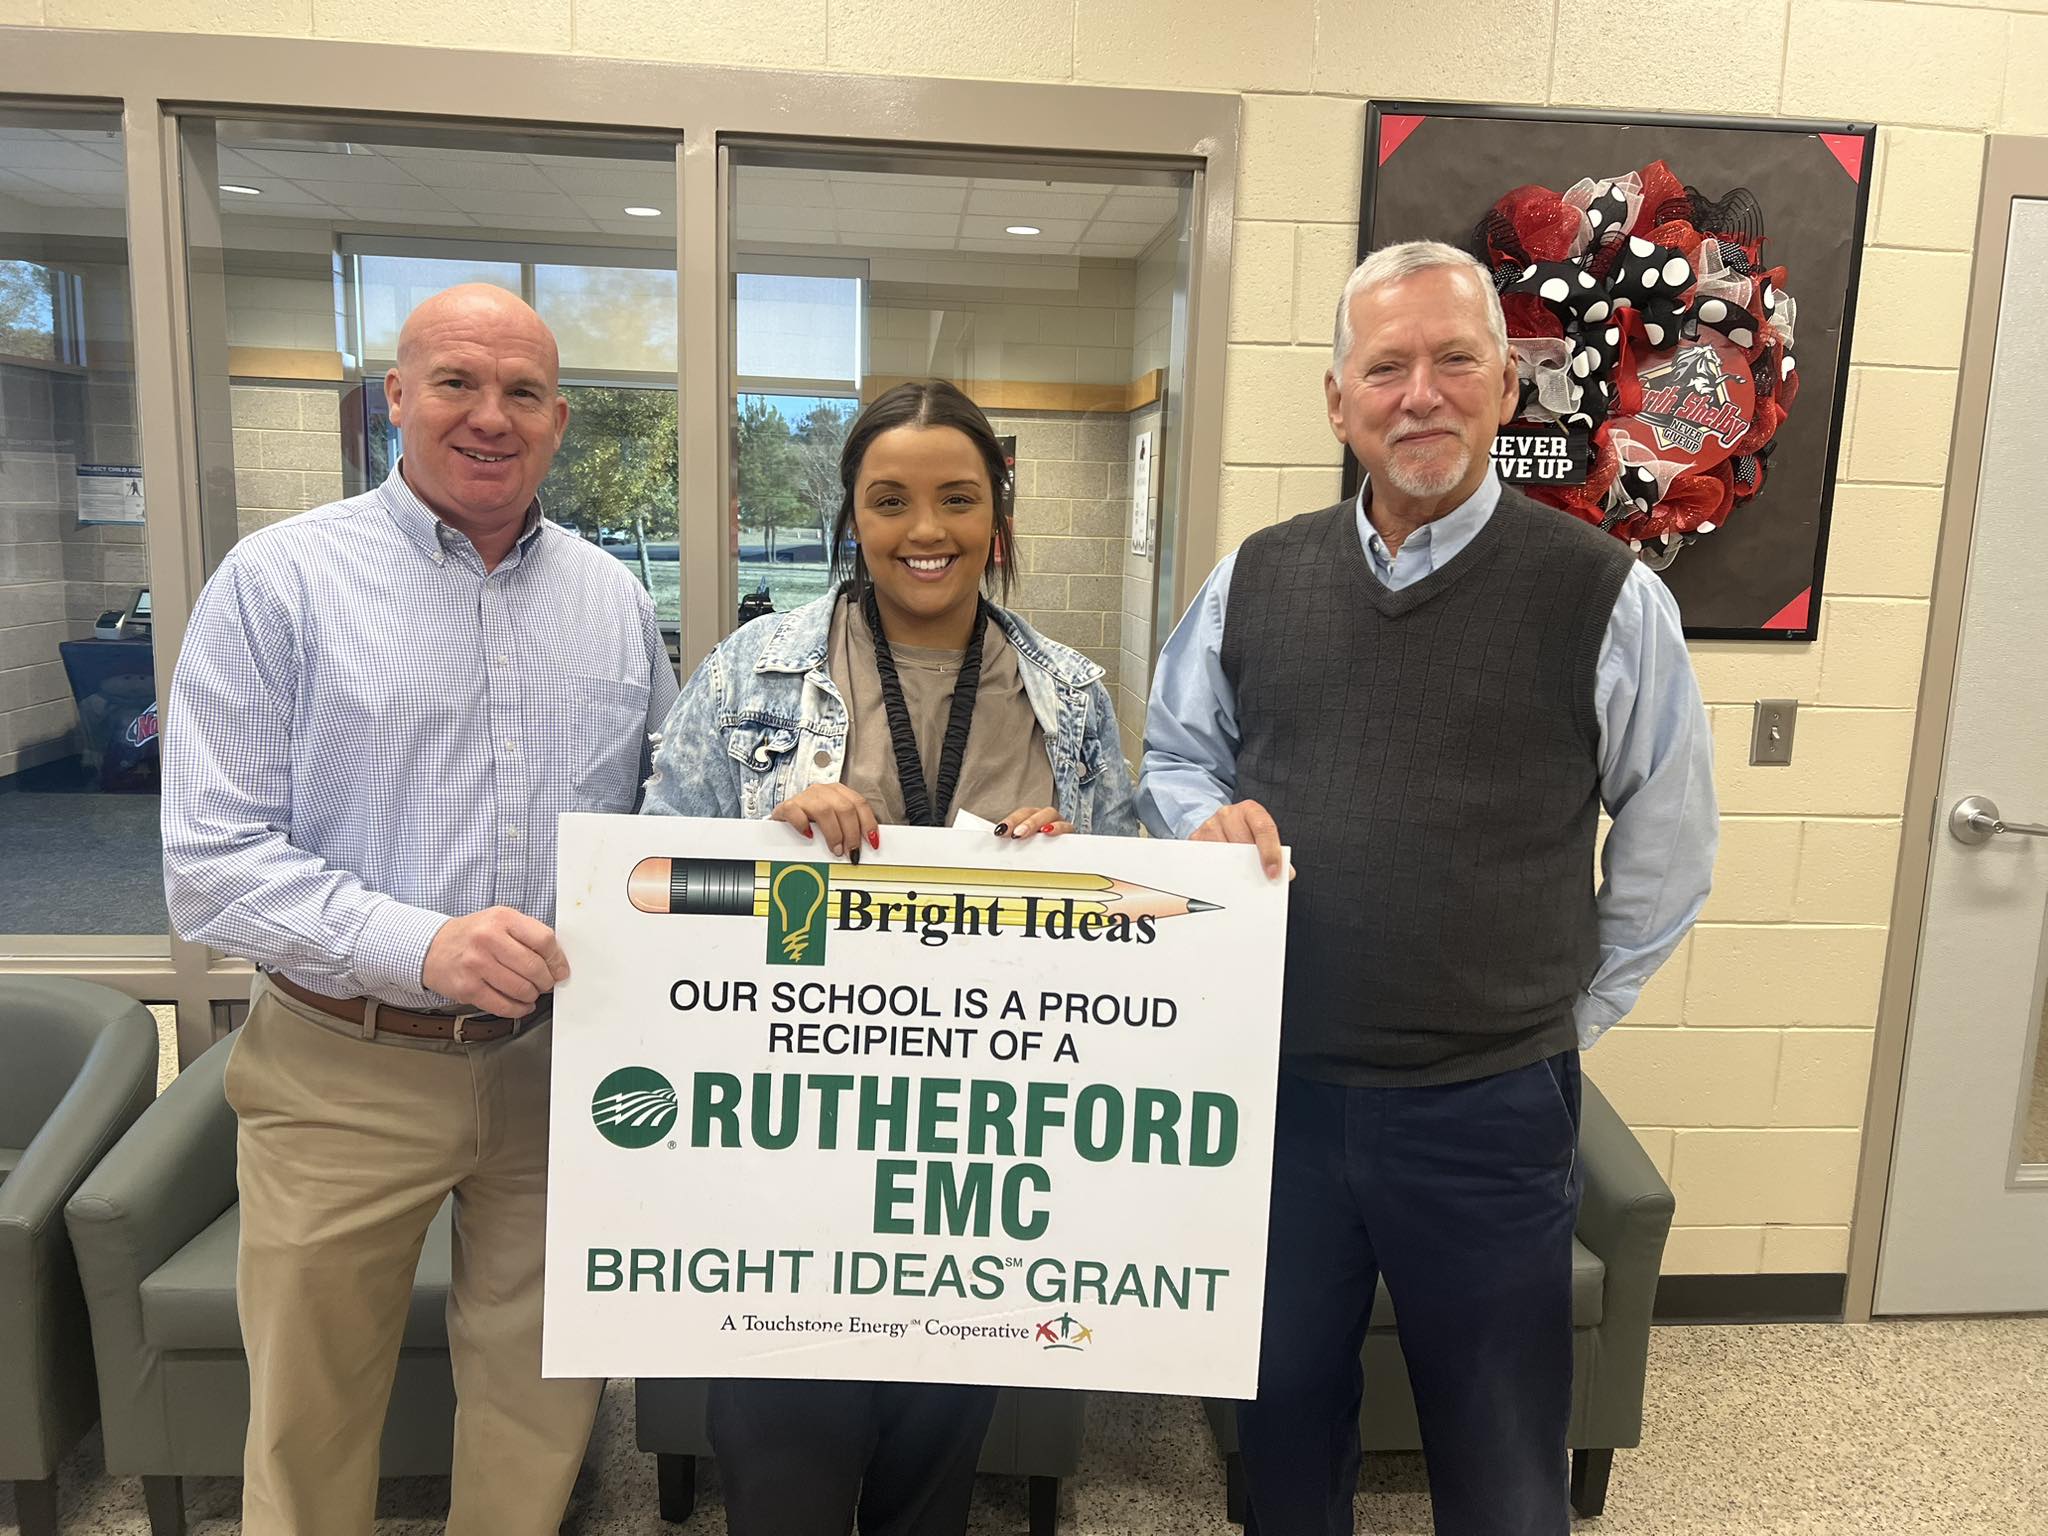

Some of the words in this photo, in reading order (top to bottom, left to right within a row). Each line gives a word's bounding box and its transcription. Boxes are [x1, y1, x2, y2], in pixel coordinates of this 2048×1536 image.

[1663, 428, 1687, 447] GIVE
[1686, 439, 1699, 452] UP
[1671, 419, 1702, 441] NEVER
[1673, 391, 1748, 443] Shelby
[1489, 458, 1532, 478] IVE
[1538, 459, 1573, 479] UP
[834, 888, 1004, 947] Bright
[1020, 896, 1157, 945] Ideas
[670, 980, 757, 1012] OUR
[772, 981, 942, 1017] SCHOOL
[955, 988, 988, 1019] IS
[1000, 991, 1026, 1021] A
[1040, 992, 1178, 1028] PROUD
[769, 1023, 979, 1059] RECIPIENT
[990, 1030, 1043, 1061] OF
[1054, 1034, 1080, 1064] A
[691, 1071, 1239, 1168] RUTHERFORD
[873, 1159, 1051, 1241] EMC
[587, 1248, 814, 1294] BRIGHT
[833, 1251, 1005, 1300] IDEAS
[1025, 1258, 1230, 1312] GRANT
[720, 1314, 737, 1331] A
[742, 1314, 843, 1332] Touchstone
[848, 1316, 909, 1338] Energy
[925, 1318, 1030, 1340] Cooperative
